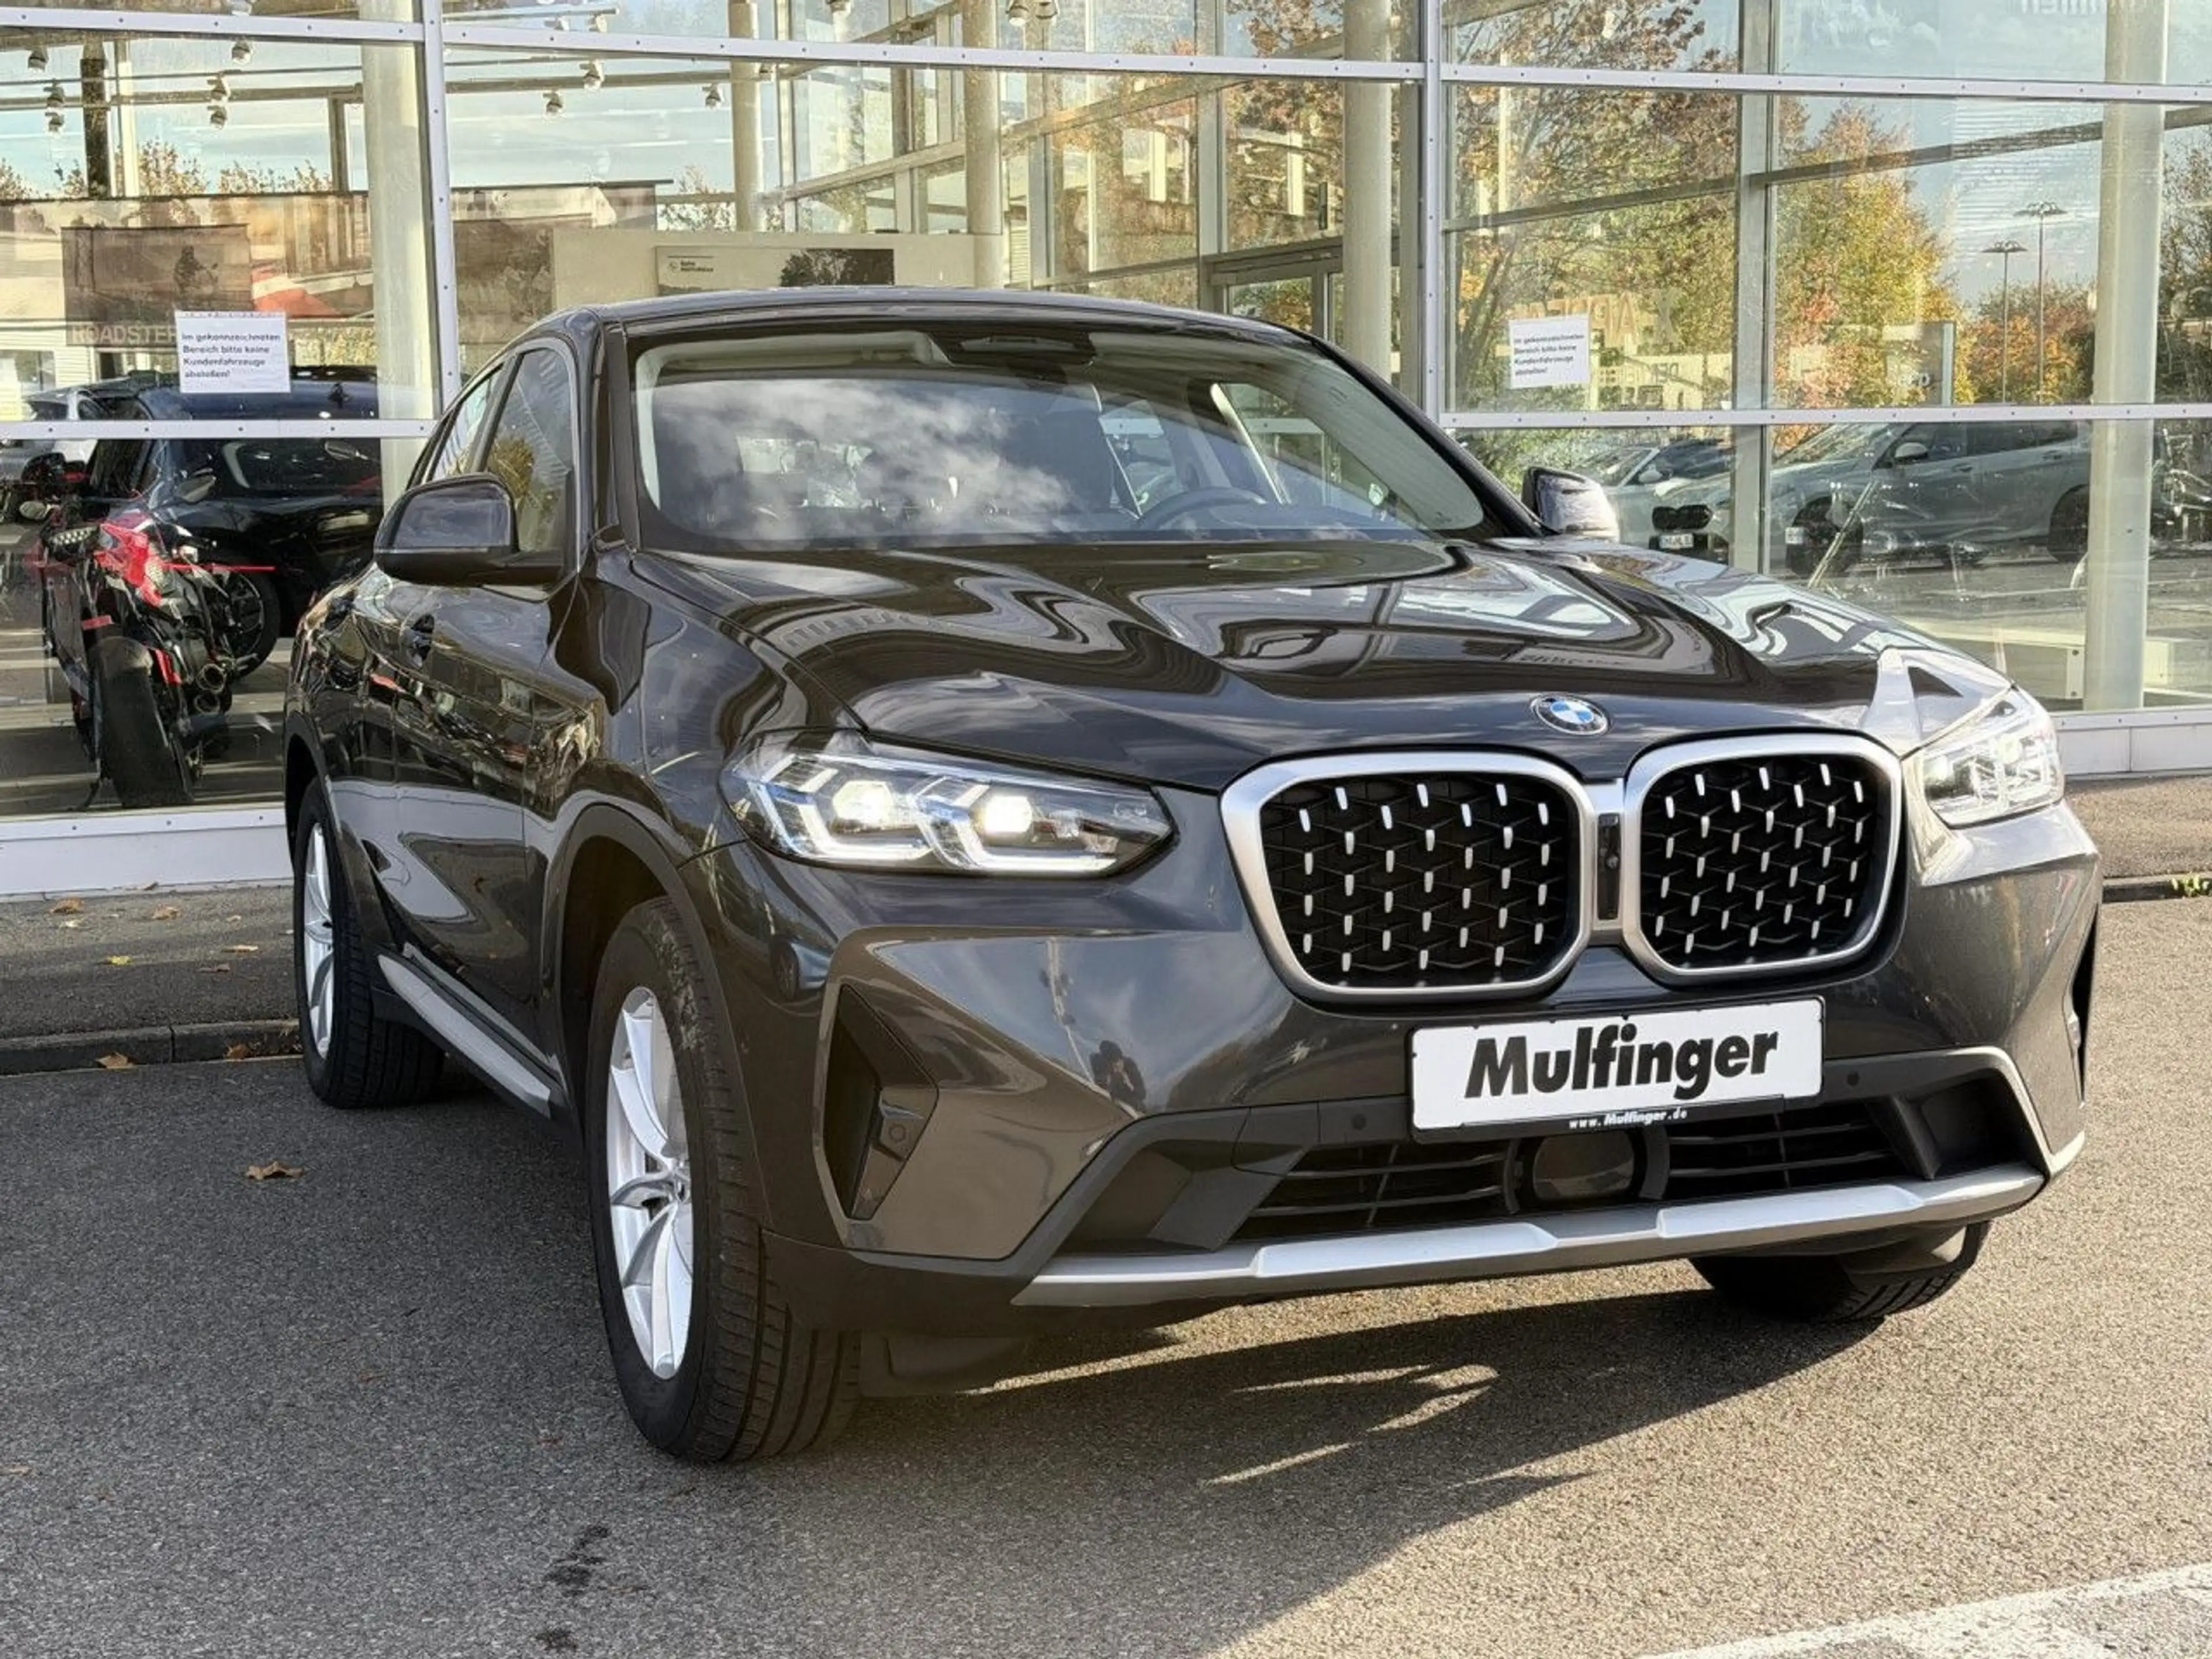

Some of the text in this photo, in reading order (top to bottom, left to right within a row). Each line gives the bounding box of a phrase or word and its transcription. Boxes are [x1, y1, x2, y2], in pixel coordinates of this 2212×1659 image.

[183, 345, 270, 354] Bereich bitte keine
[183, 358, 266, 367] Kundenfahrzeuge
[1464, 1023, 1779, 1100] Mulfinger
